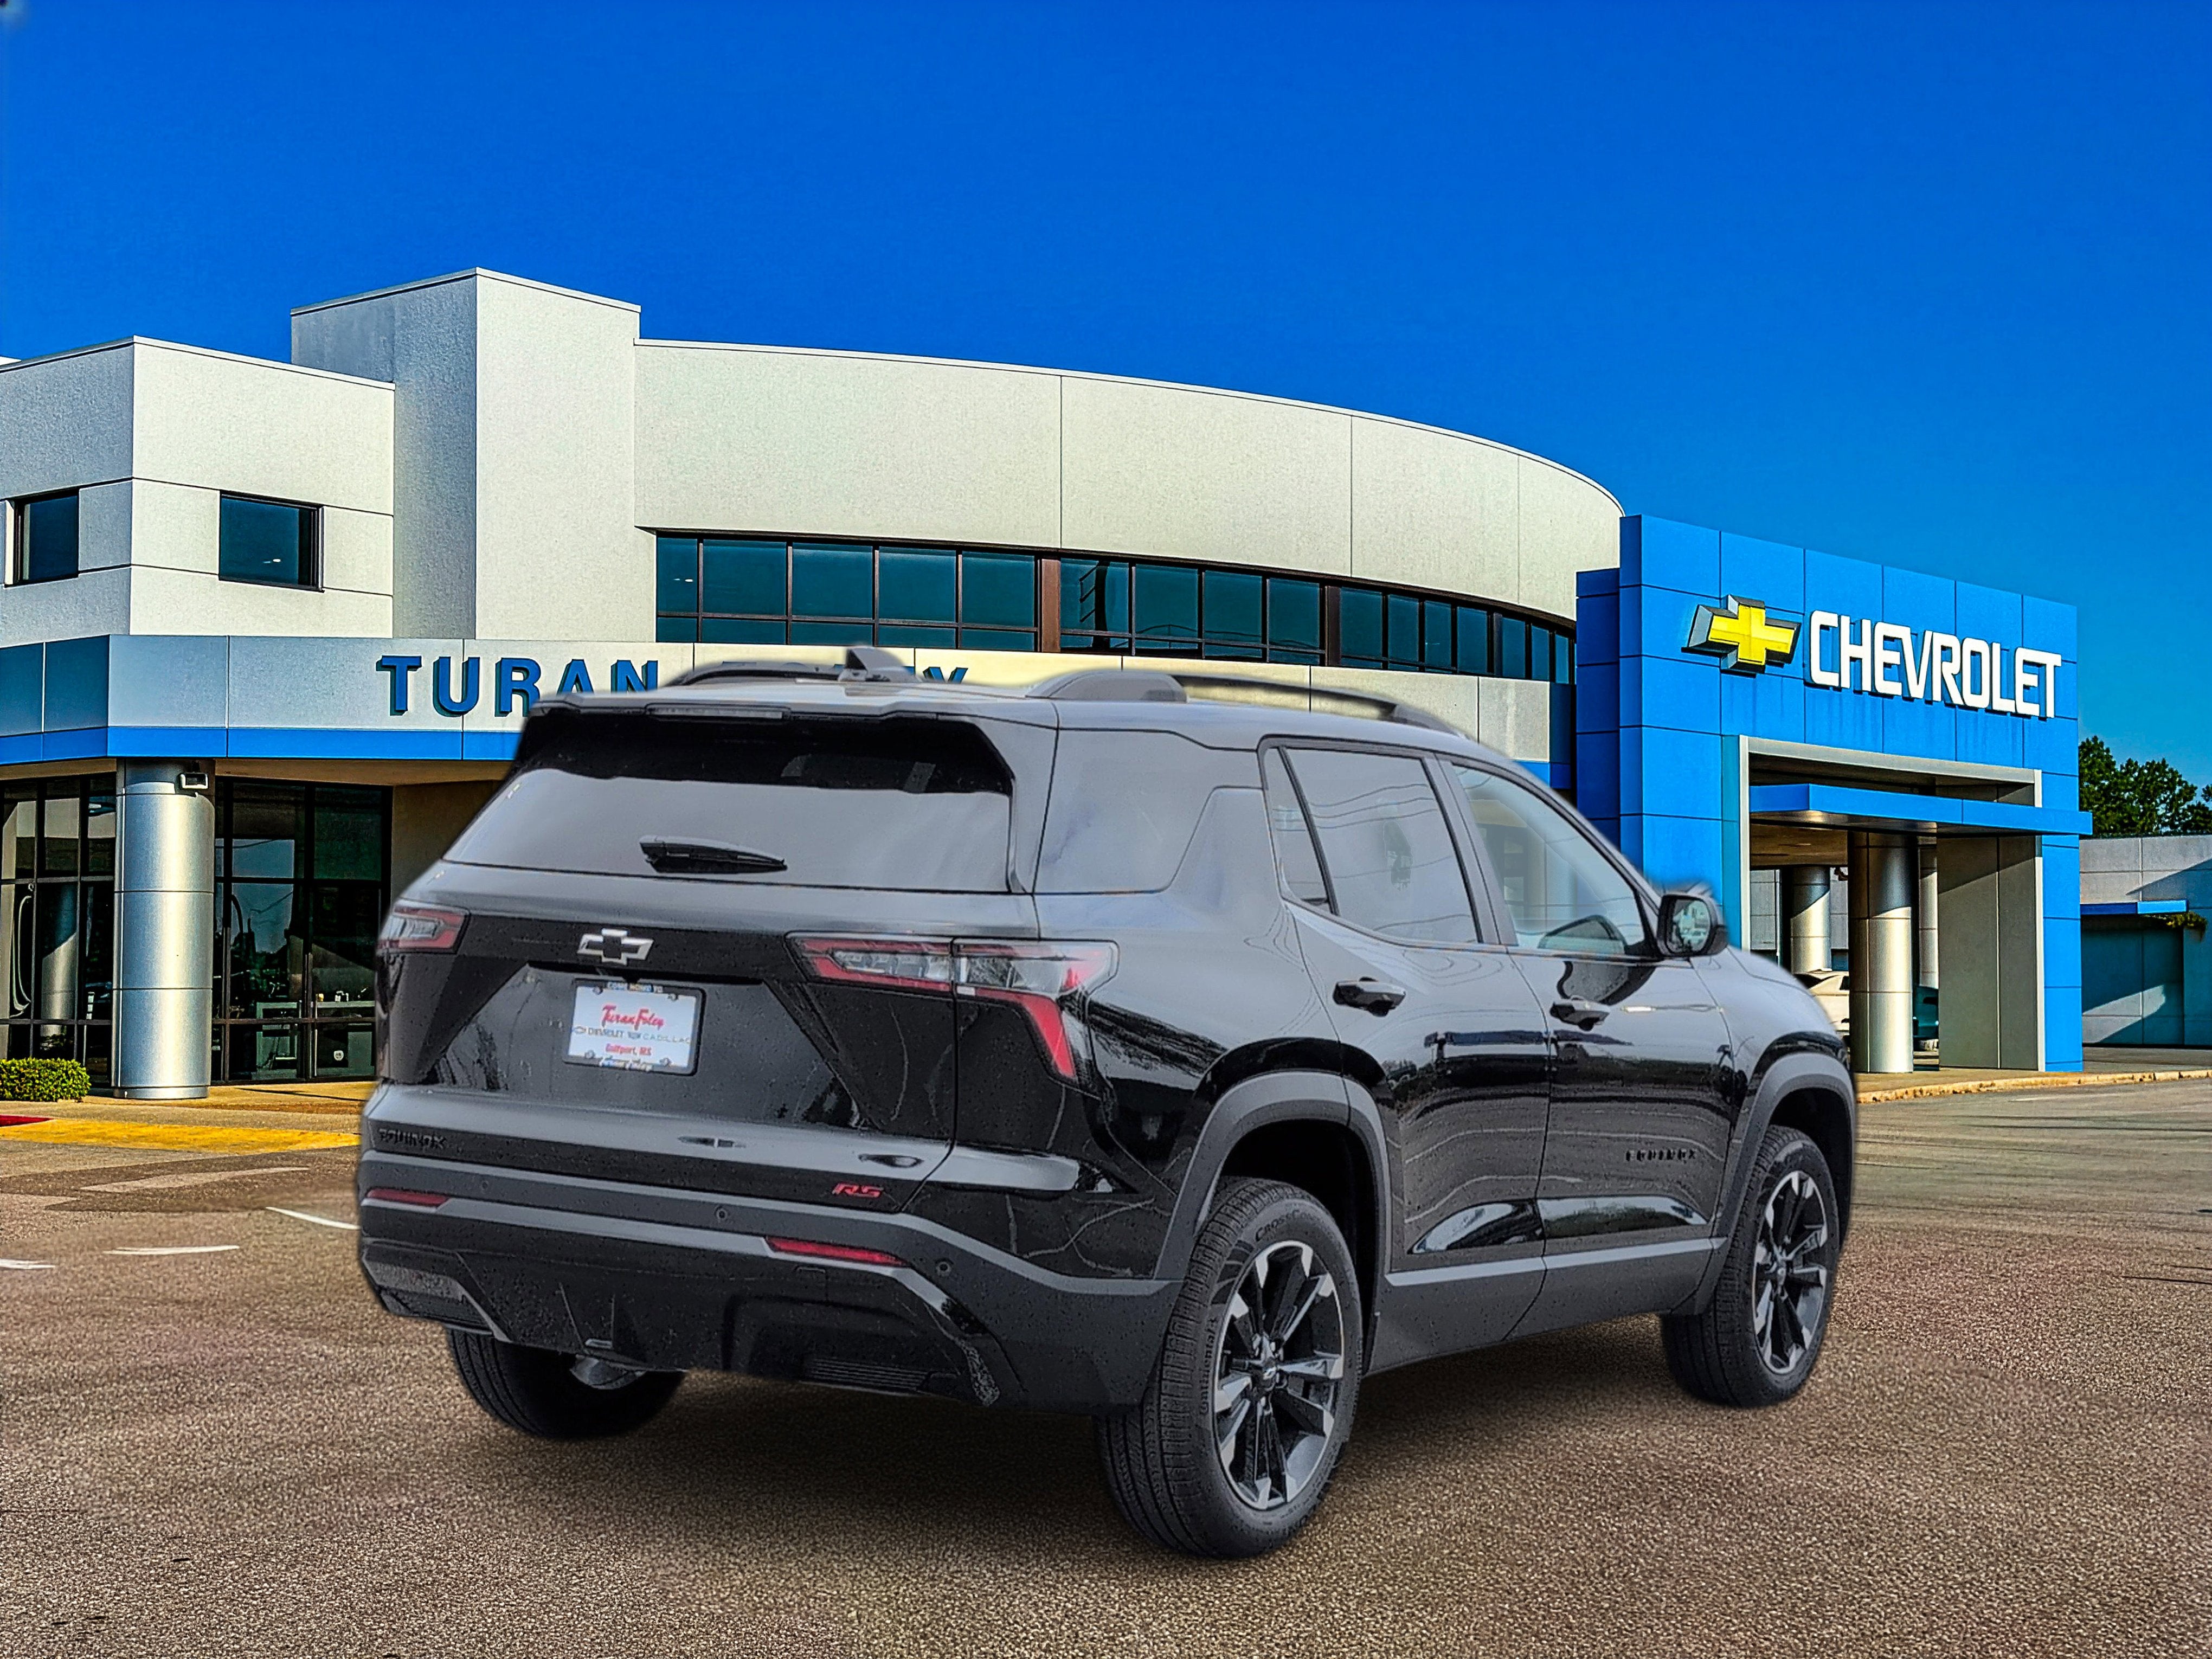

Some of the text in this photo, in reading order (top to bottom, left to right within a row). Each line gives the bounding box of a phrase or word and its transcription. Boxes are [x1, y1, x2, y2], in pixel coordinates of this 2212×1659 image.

[1810, 610, 2062, 718] CHEVROLET
[375, 654, 659, 717] TURAN
[642, 1032, 691, 1044] CADILLAC
[378, 1128, 448, 1150] EQUINOX
[831, 1182, 884, 1198] RS
